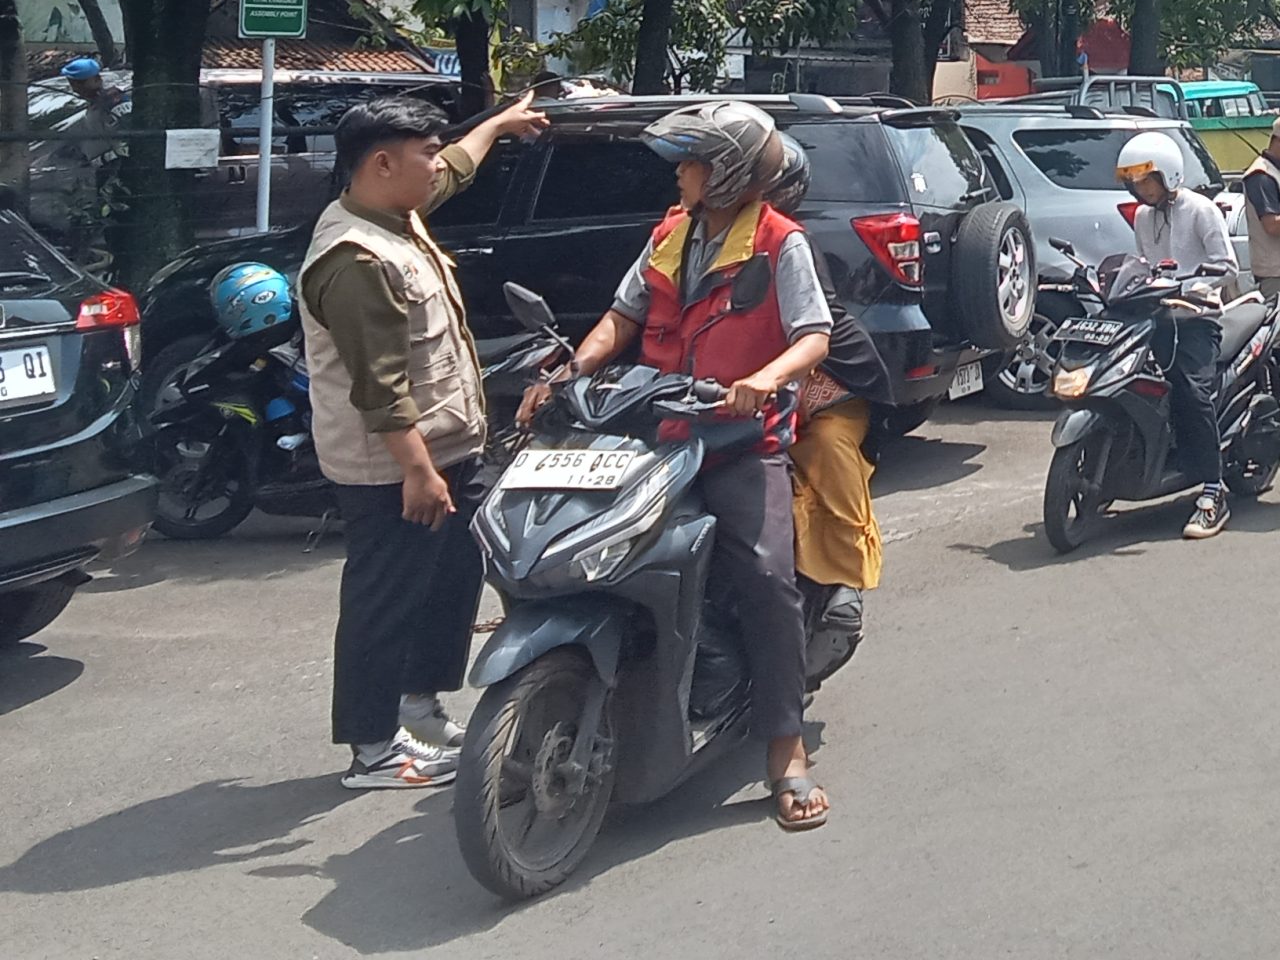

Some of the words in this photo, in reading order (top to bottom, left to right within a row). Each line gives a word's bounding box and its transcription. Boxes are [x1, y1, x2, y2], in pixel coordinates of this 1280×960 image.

[250, 10, 280, 18] ASSEMBLY
[279, 10, 299, 18] POINT
[514, 453, 528, 469] D
